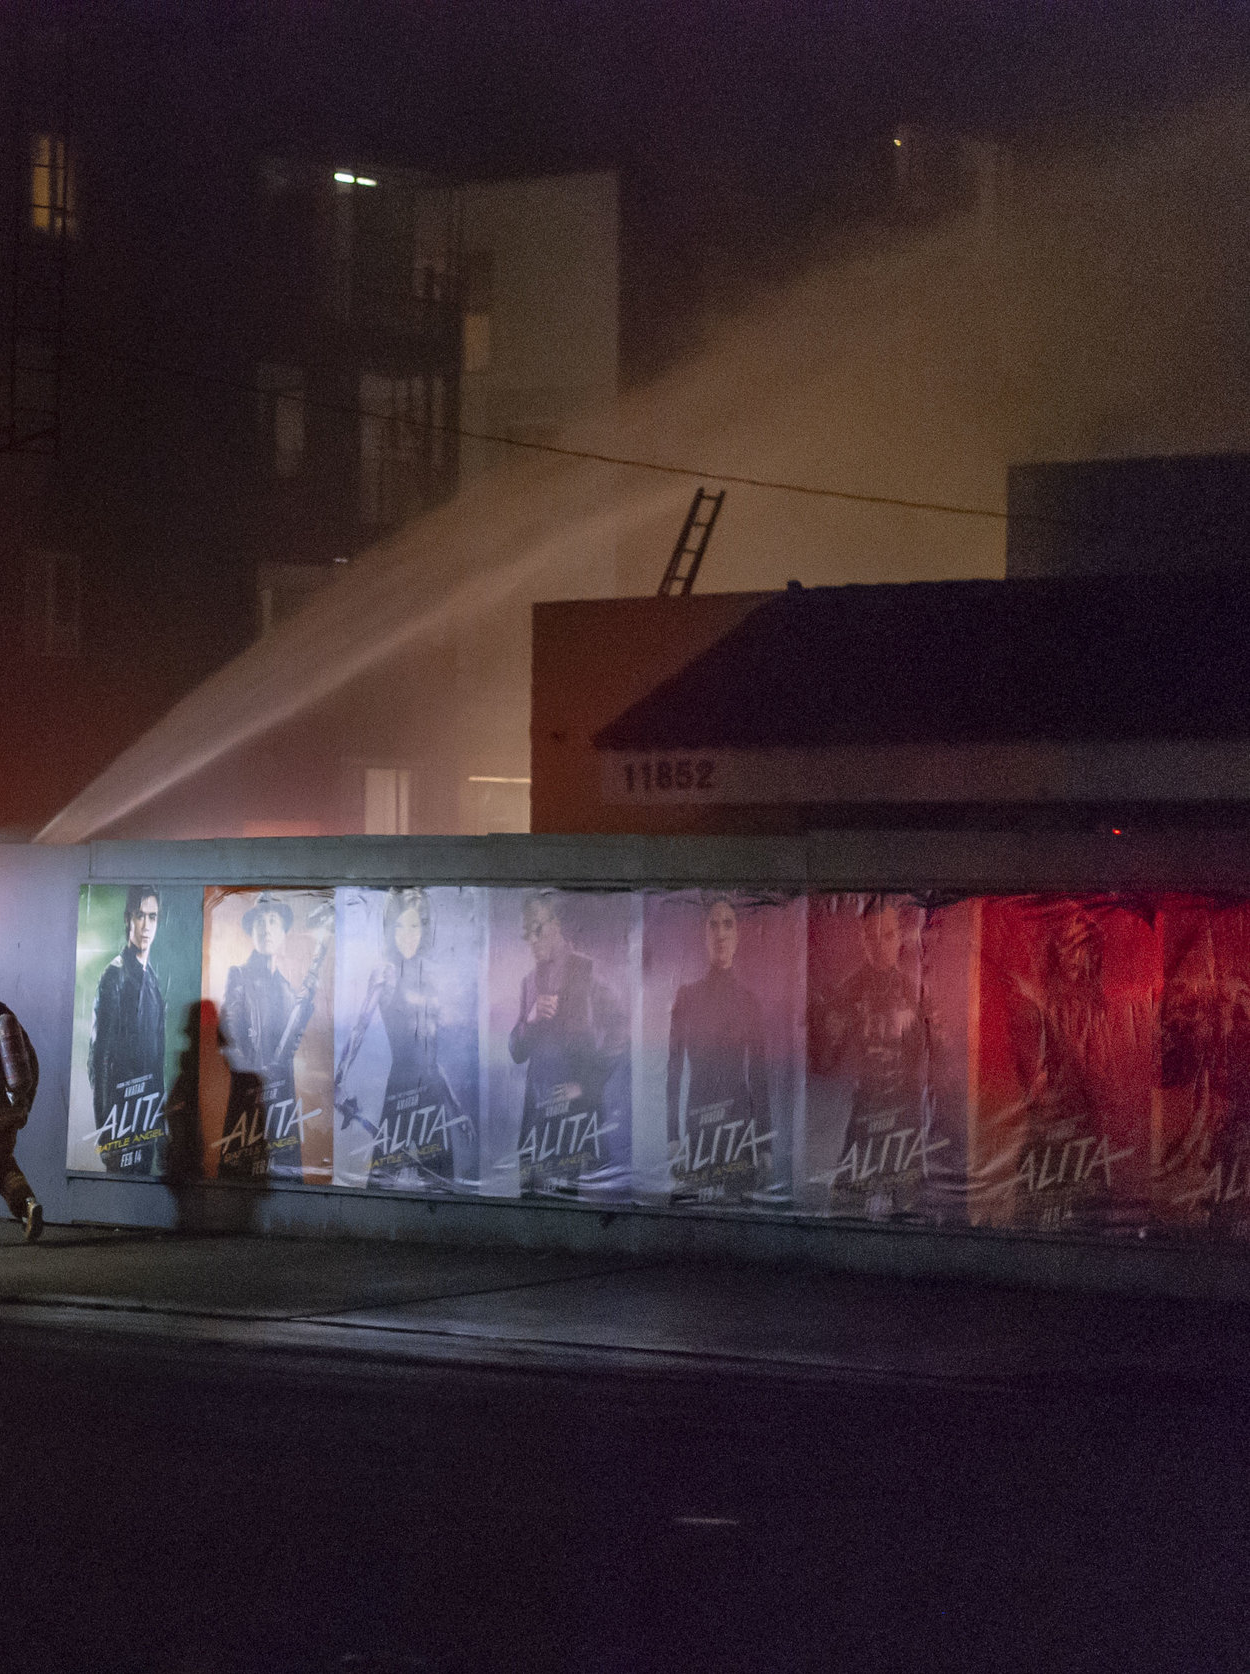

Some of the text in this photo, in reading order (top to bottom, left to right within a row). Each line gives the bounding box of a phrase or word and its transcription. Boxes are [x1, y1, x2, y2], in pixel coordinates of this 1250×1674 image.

[623, 758, 715, 794] 11852
[82, 1091, 183, 1147] ALITA
[95, 1137, 131, 1154] BATTLE
[132, 1128, 165, 1143] ANGEL
[210, 1097, 323, 1156] ALITA
[350, 1103, 470, 1163] ALITA
[498, 1110, 619, 1168] ALITA
[665, 1118, 778, 1177] ALITA
[120, 1152, 133, 1168] FEB
[808, 1127, 950, 1187] ALITA
[990, 1133, 1137, 1197] ALITA
